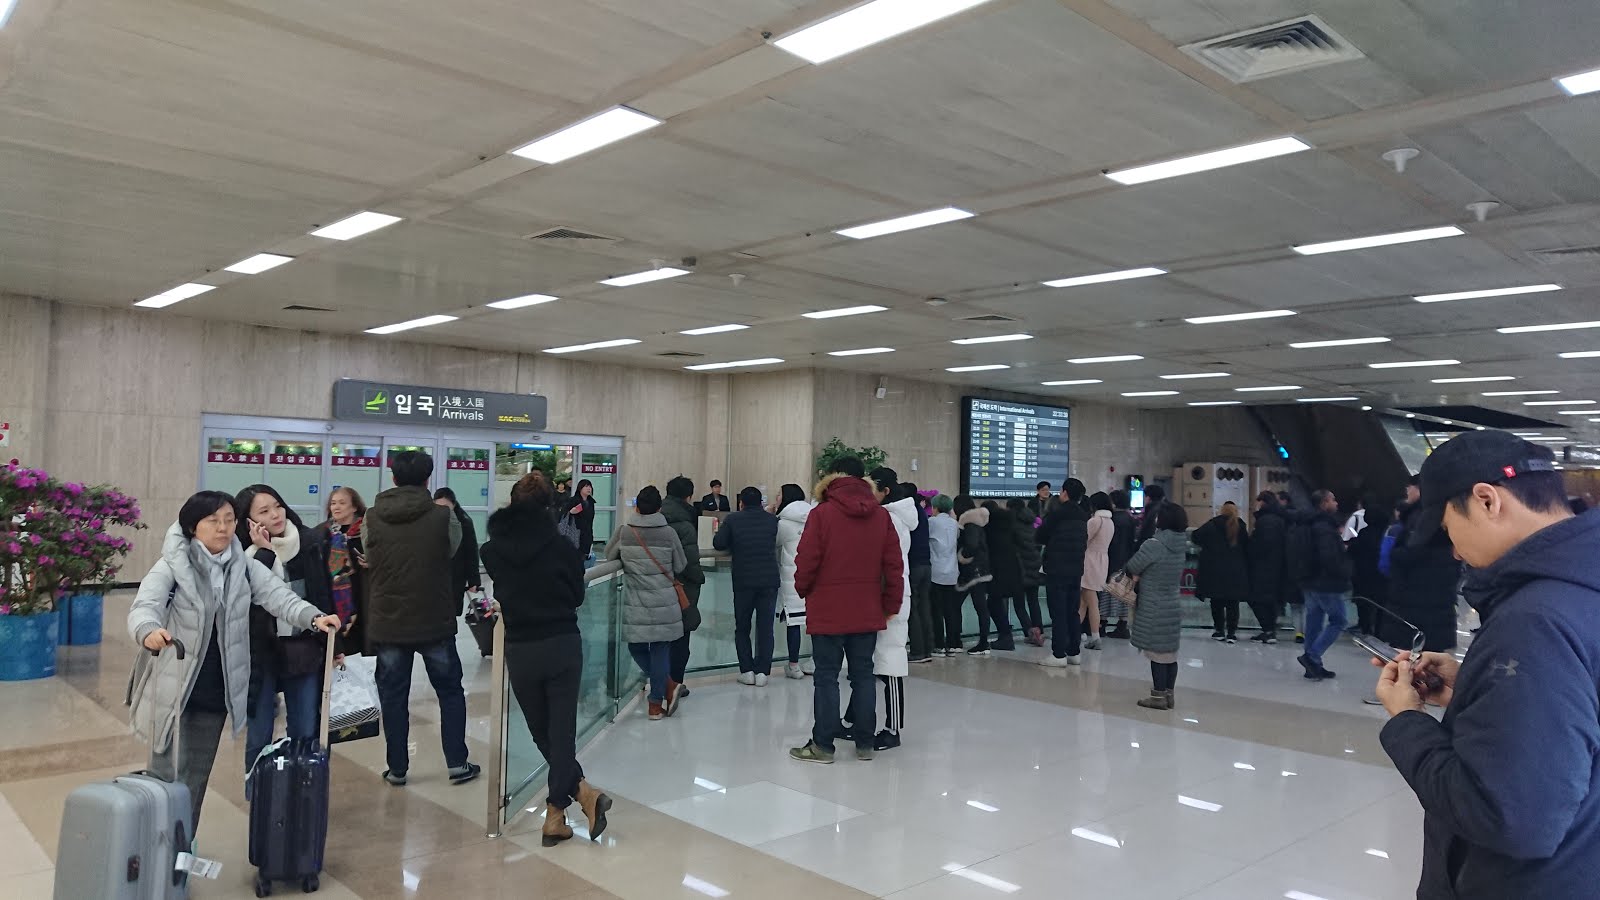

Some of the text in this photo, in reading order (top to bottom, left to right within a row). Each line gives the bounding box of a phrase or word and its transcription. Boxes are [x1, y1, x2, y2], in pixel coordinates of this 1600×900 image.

[442, 409, 484, 421] Arrivals
[276, 455, 317, 464] 진입금지
[595, 466, 614, 474] ENTRY
